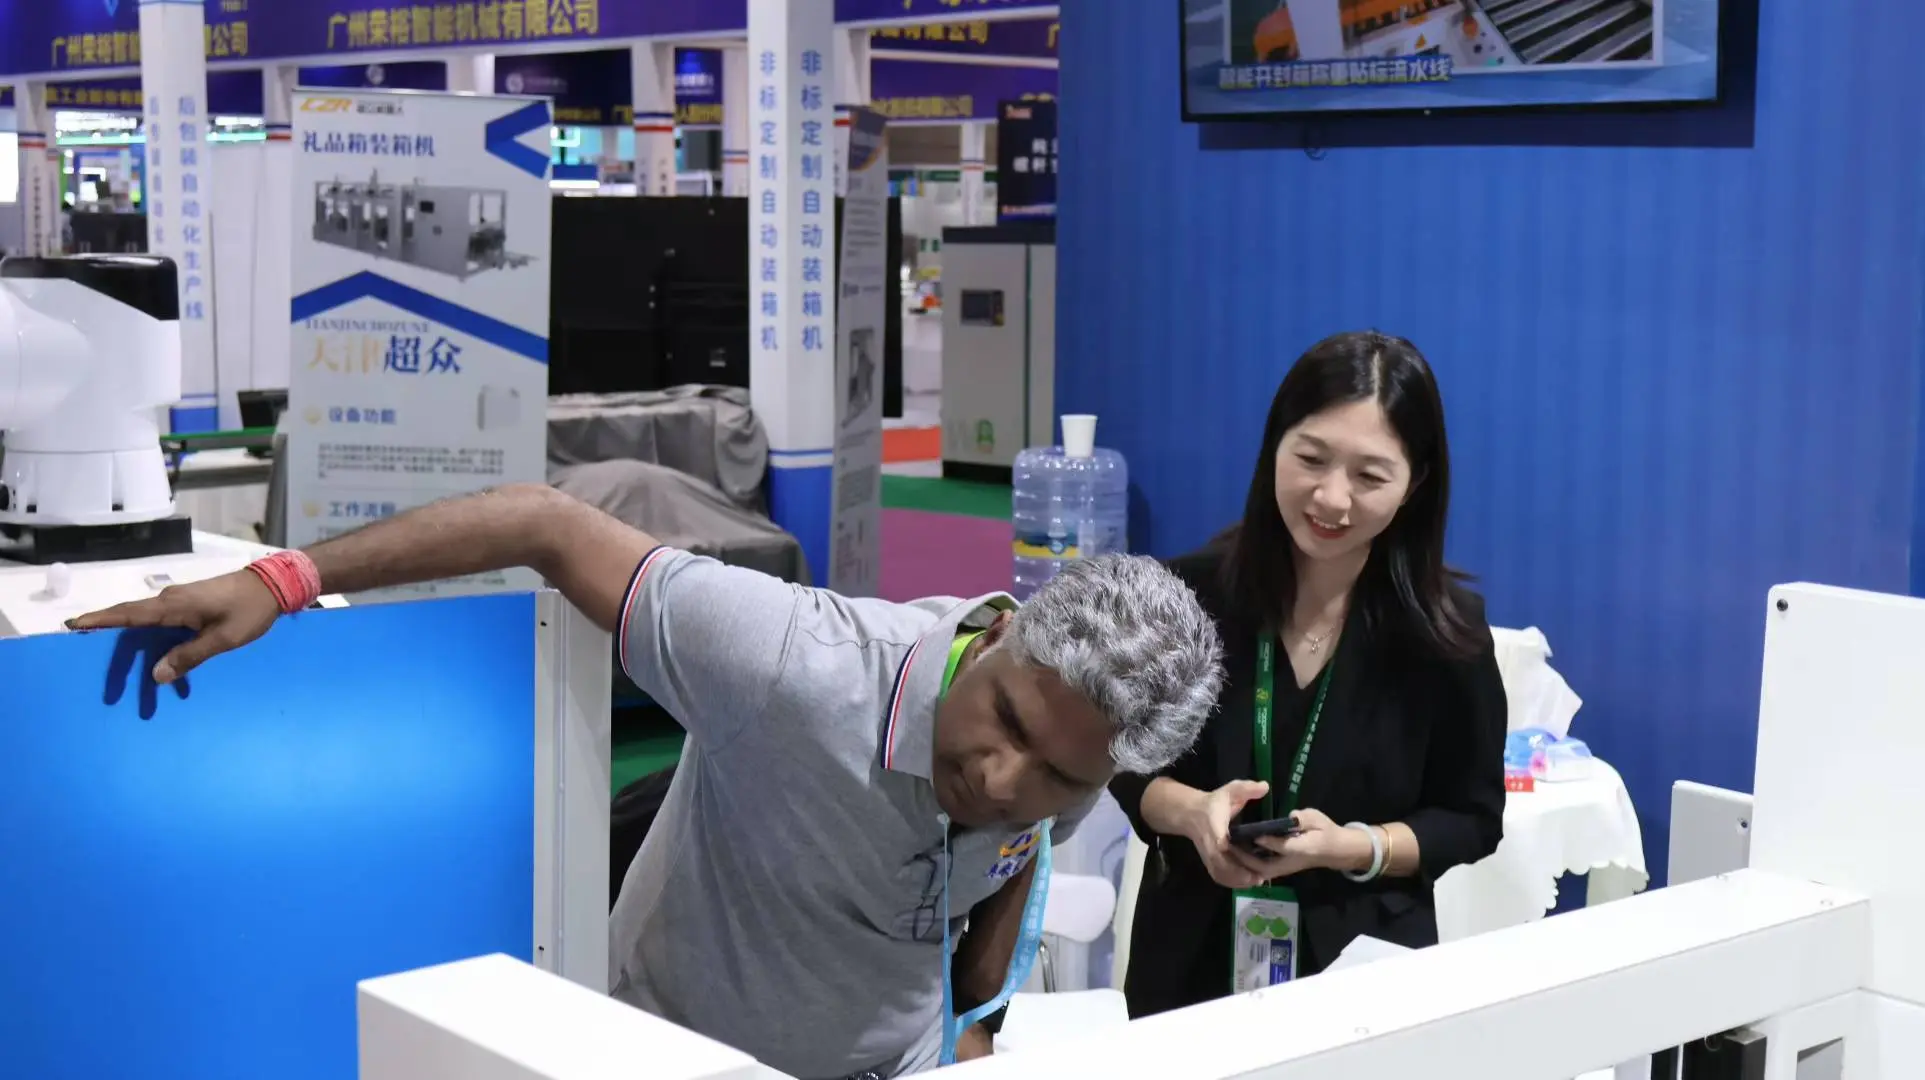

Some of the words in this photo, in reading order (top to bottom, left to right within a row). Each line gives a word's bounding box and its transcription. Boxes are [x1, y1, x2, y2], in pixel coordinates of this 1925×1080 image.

[304, 131, 435, 157] 礼品箱装箱机
[760, 49, 778, 351] 非标定制自动装箱机
[801, 49, 823, 351] 非标定制自动装箱机
[308, 335, 463, 375] 天津超众
[328, 407, 397, 424] 设备功能
